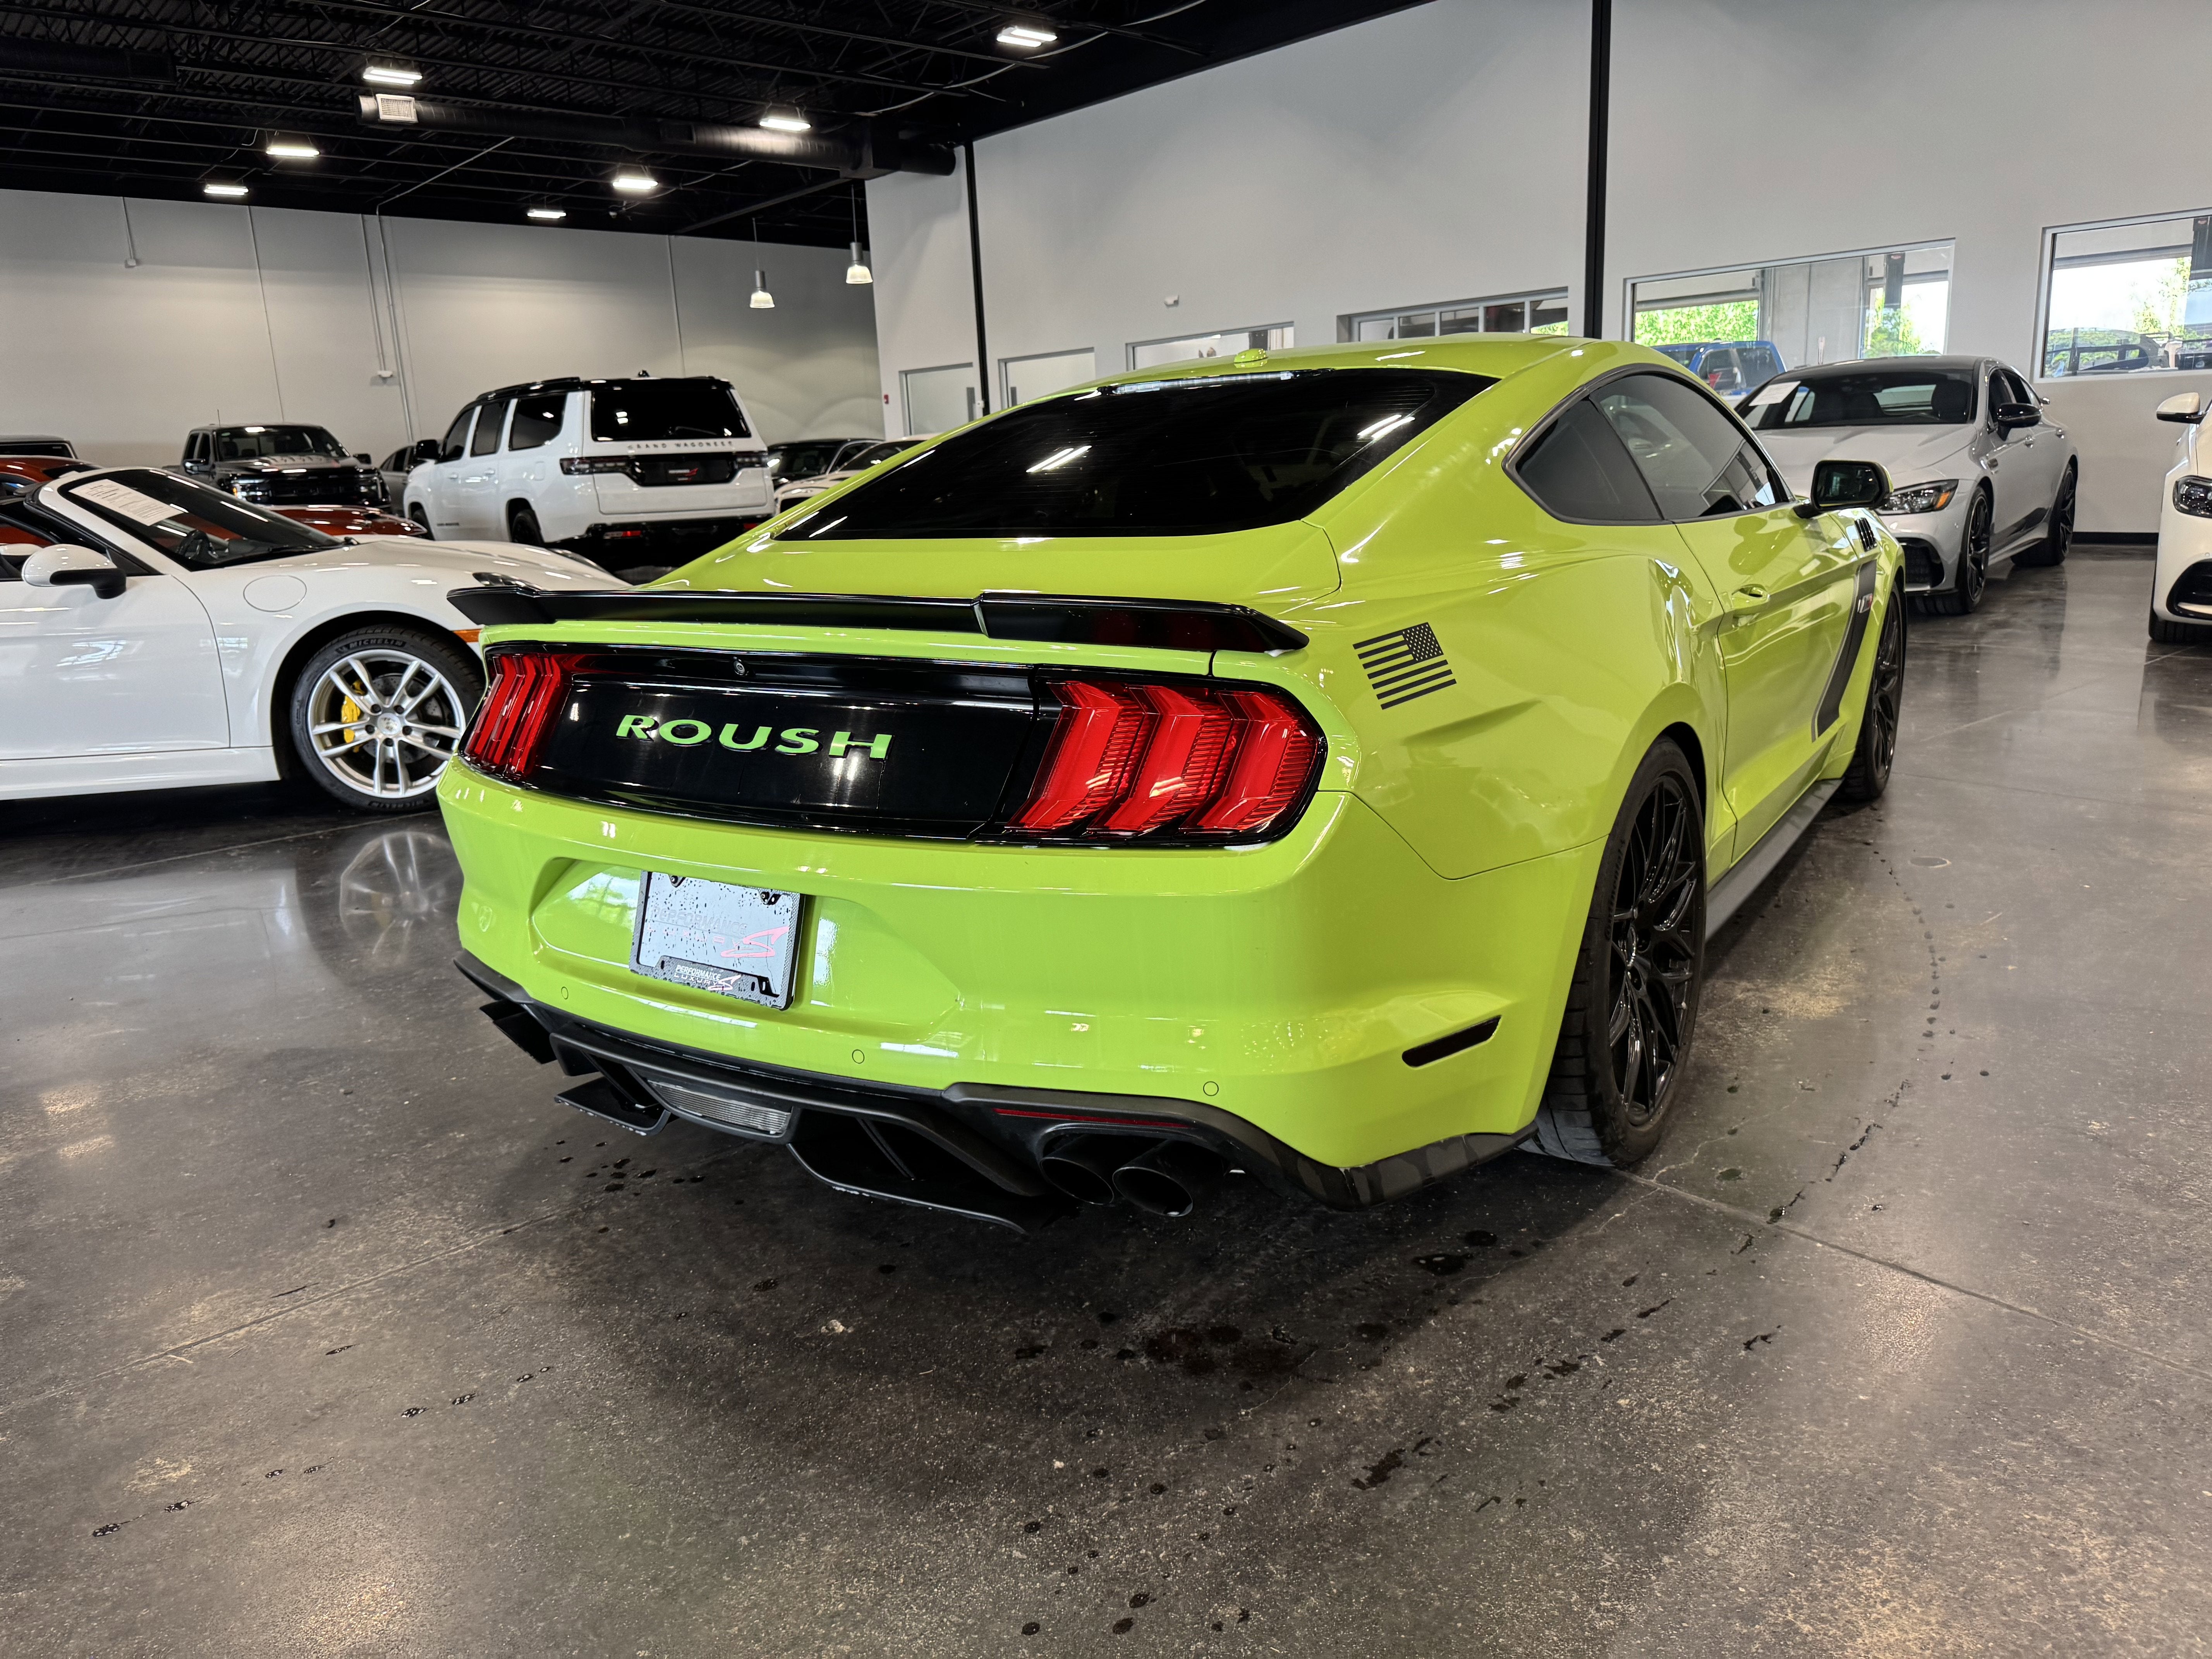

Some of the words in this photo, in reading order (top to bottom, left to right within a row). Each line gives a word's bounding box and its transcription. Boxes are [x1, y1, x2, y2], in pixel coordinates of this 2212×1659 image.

[349, 639, 404, 649] MICHELIN
[616, 714, 894, 759] ROUSH
[650, 906, 748, 936] PERFORMANCE
[675, 965, 721, 981] PERFORMANCE
